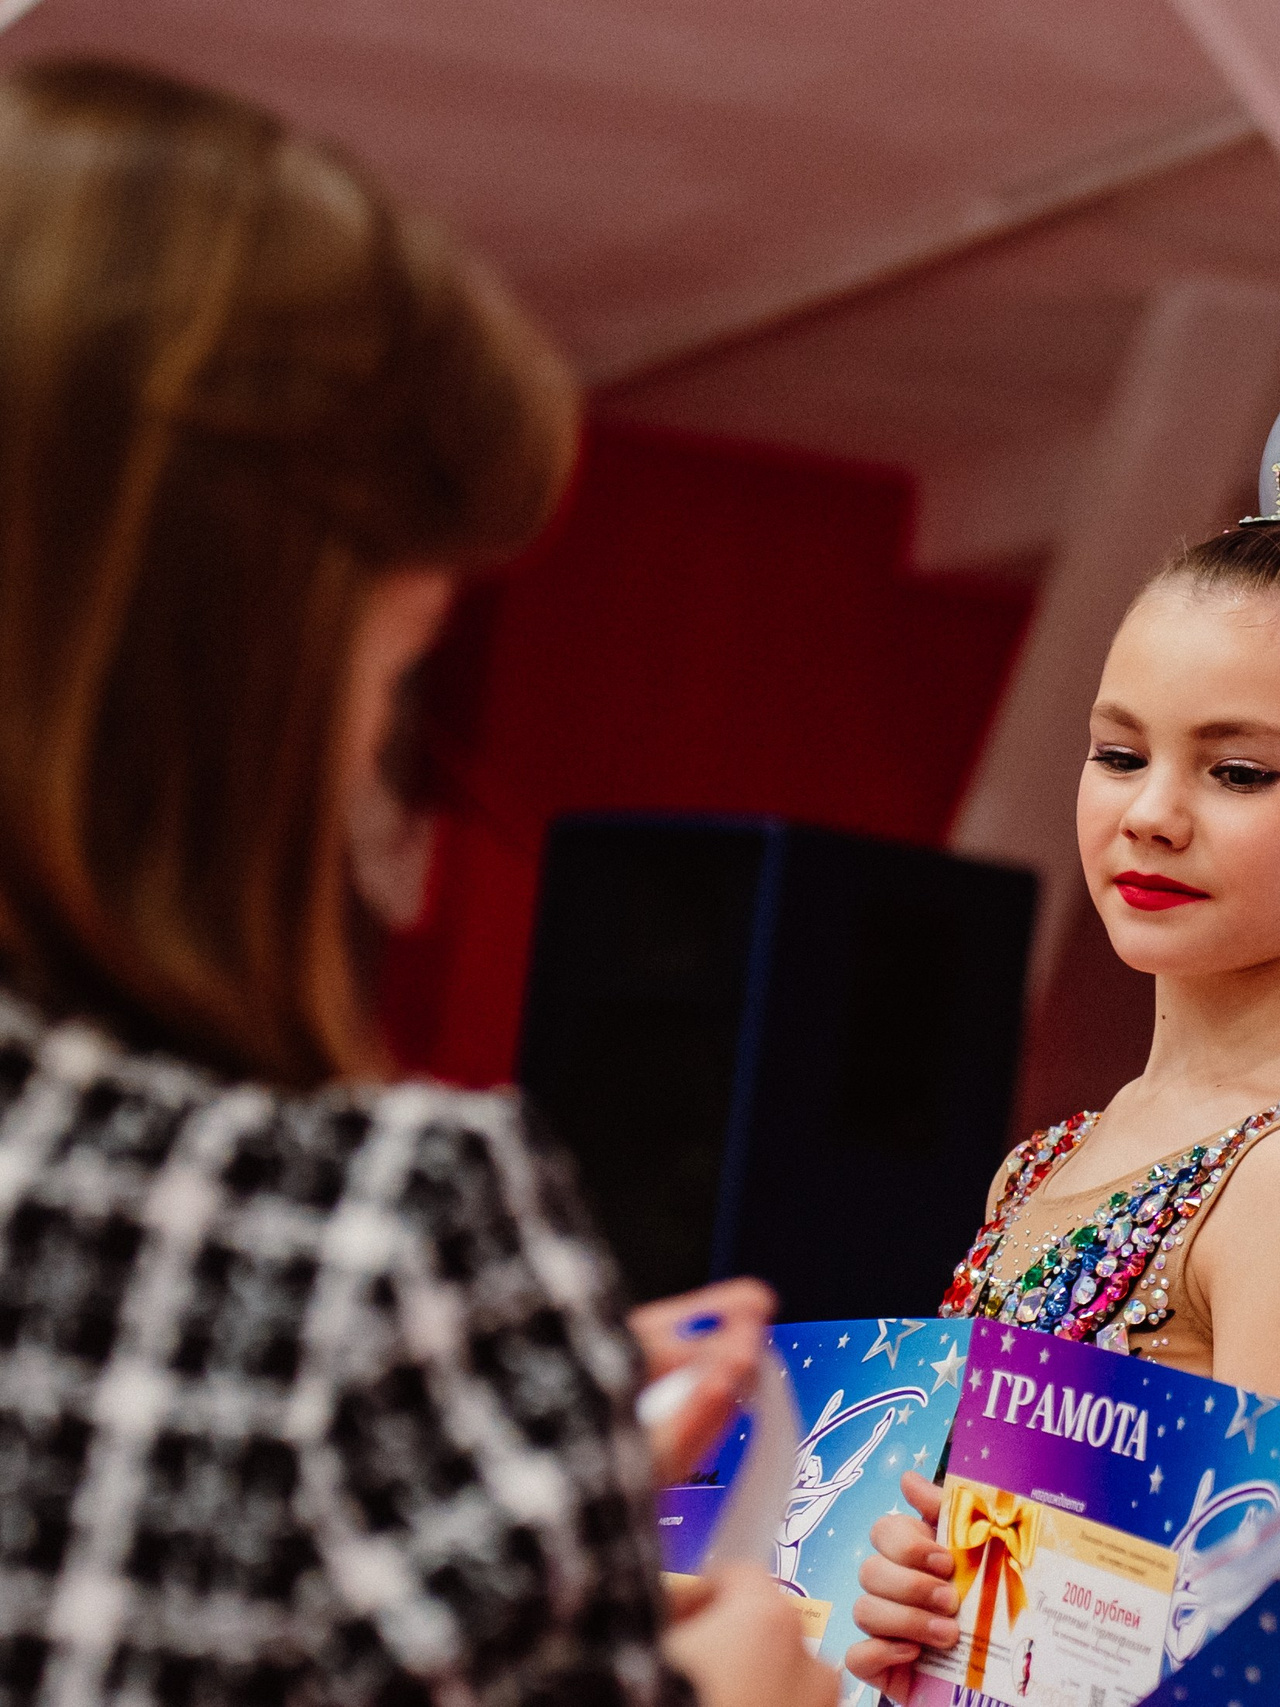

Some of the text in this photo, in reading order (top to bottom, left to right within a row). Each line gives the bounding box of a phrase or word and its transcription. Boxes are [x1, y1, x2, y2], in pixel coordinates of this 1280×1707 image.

[982, 1370, 1149, 1462] ГРАМОТА
[1062, 1581, 1142, 1630] 2000 рублей
